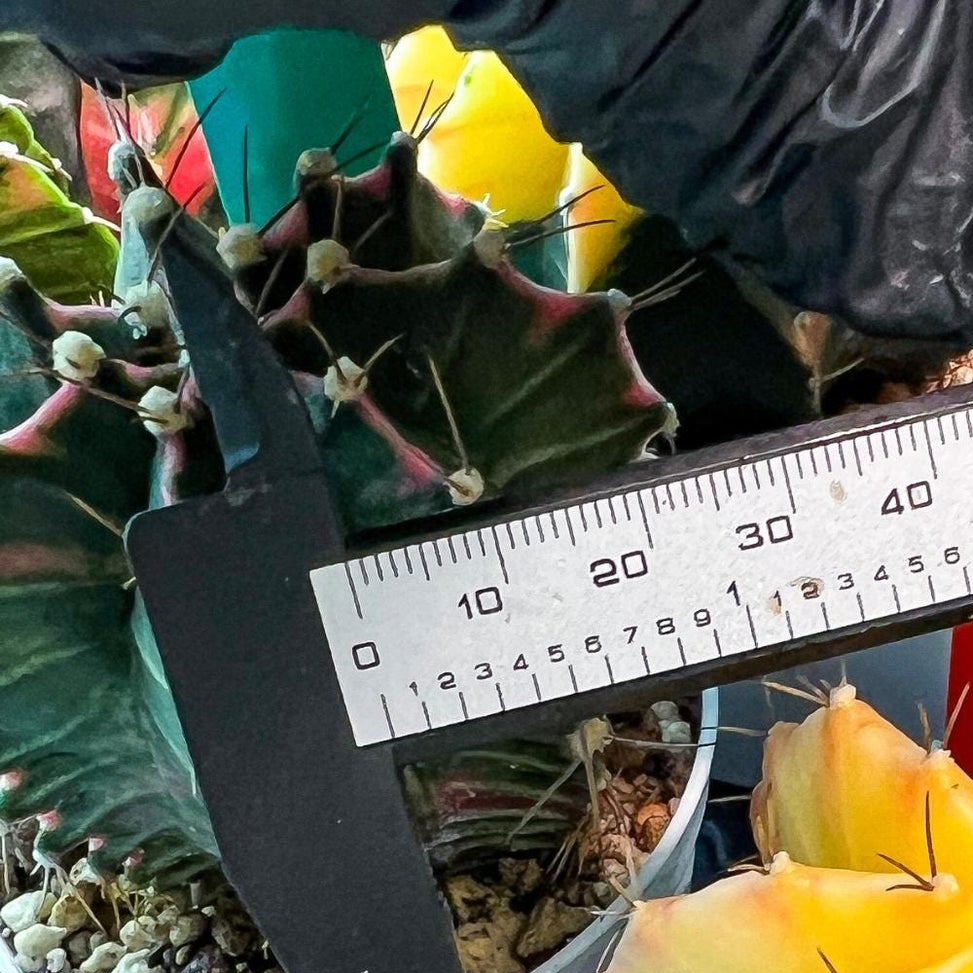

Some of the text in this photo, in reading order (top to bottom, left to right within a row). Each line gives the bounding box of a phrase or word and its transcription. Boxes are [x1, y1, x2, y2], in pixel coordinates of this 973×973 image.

[352, 642, 380, 670] 0
[458, 587, 503, 619] 10
[590, 551, 648, 588] 20
[736, 515, 793, 550] 30
[881, 481, 932, 515] 40
[438, 672, 456, 690] 2
[475, 663, 492, 680] 3
[513, 654, 529, 671] 4
[548, 644, 565, 662] 5
[585, 635, 602, 653] 6
[623, 626, 637, 644] 7
[656, 618, 675, 635] 8
[694, 609, 711, 627] 9
[727, 581, 740, 606] 1
[801, 579, 820, 599] 2
[838, 573, 854, 590] 3
[874, 565, 889, 581] 4
[908, 555, 924, 573] 5
[944, 547, 960, 564] 6
